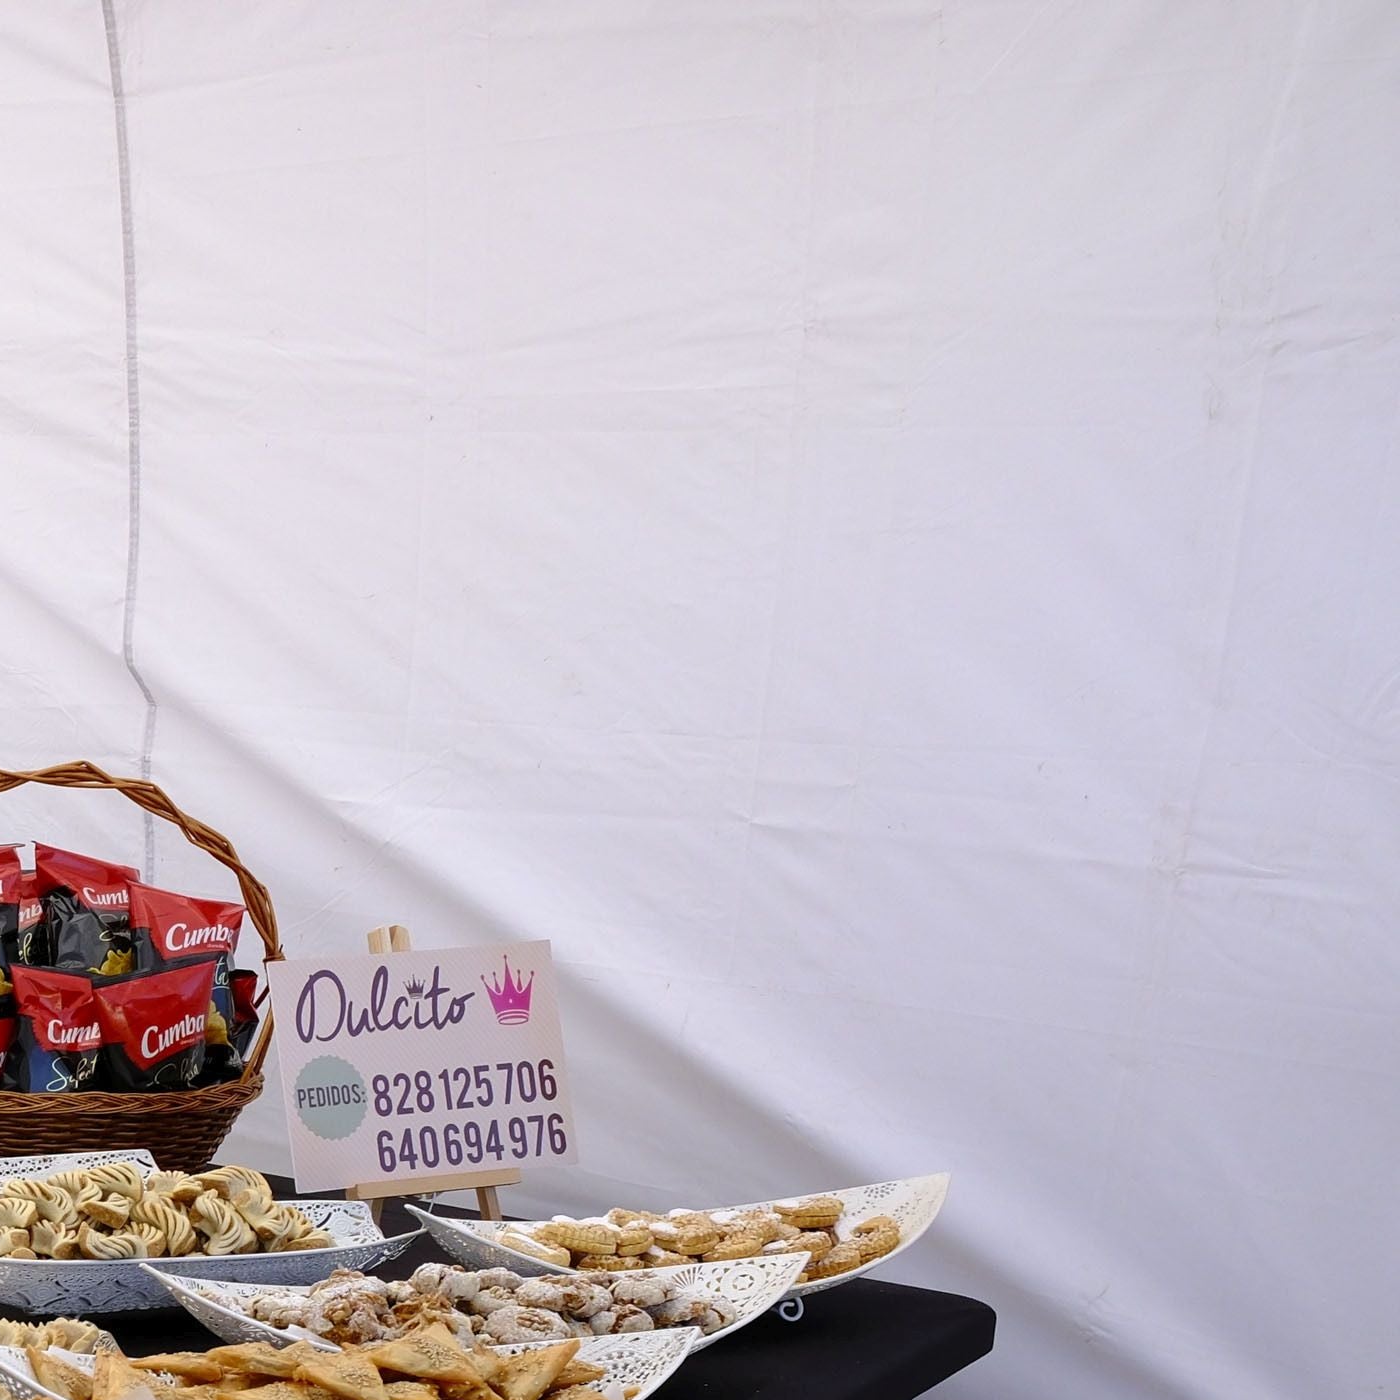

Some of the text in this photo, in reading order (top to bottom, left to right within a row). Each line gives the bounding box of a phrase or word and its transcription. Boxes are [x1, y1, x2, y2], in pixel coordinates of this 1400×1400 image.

[295, 965, 476, 1043] Dulcito
[141, 1013, 205, 1059] Cumba
[296, 1083, 367, 1109] PEDIDOS:
